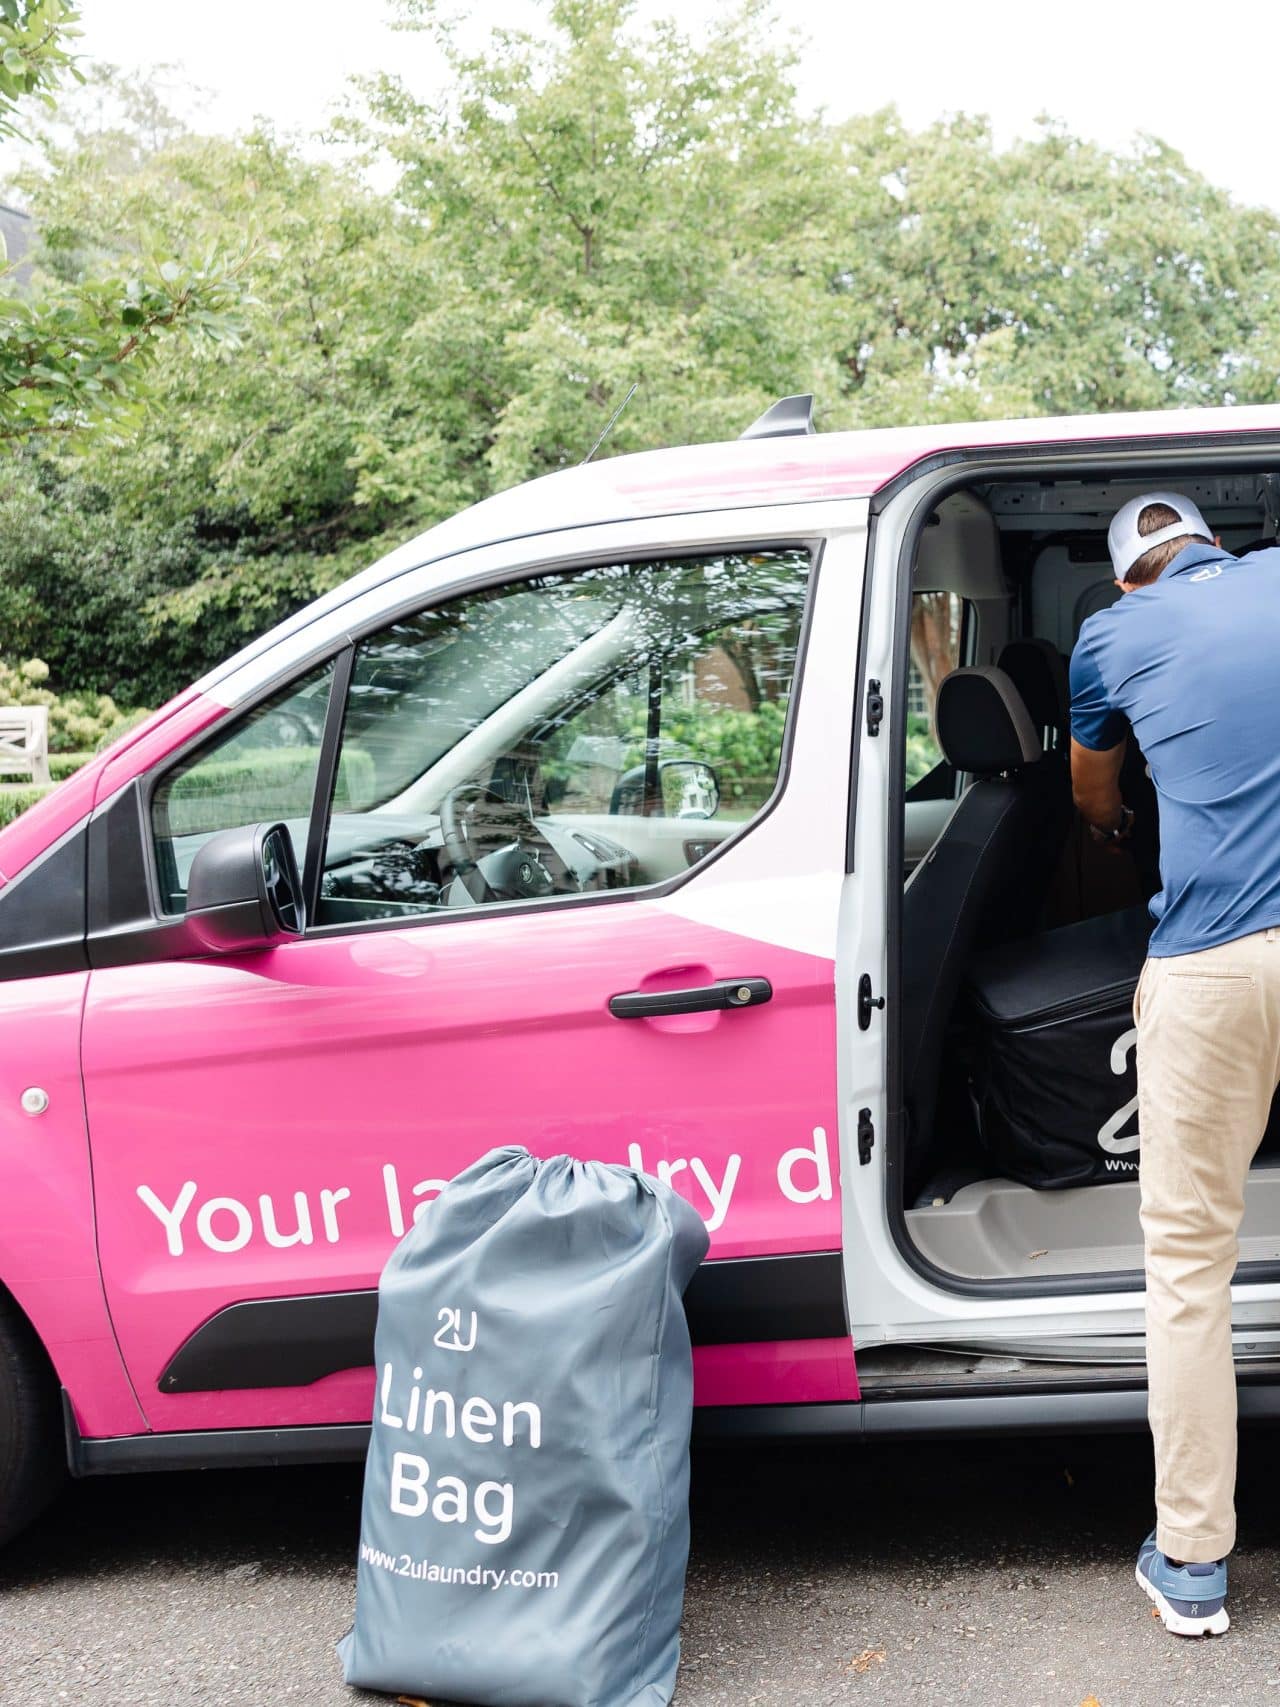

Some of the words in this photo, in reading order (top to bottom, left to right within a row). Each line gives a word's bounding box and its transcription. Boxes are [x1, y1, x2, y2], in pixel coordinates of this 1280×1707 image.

[136, 1181, 351, 1257] Your
[433, 1307, 477, 1352] 2U
[381, 1362, 541, 1449] Linen
[390, 1451, 514, 1544] Bag
[361, 1543, 560, 1590] www.2ulaundry.com
